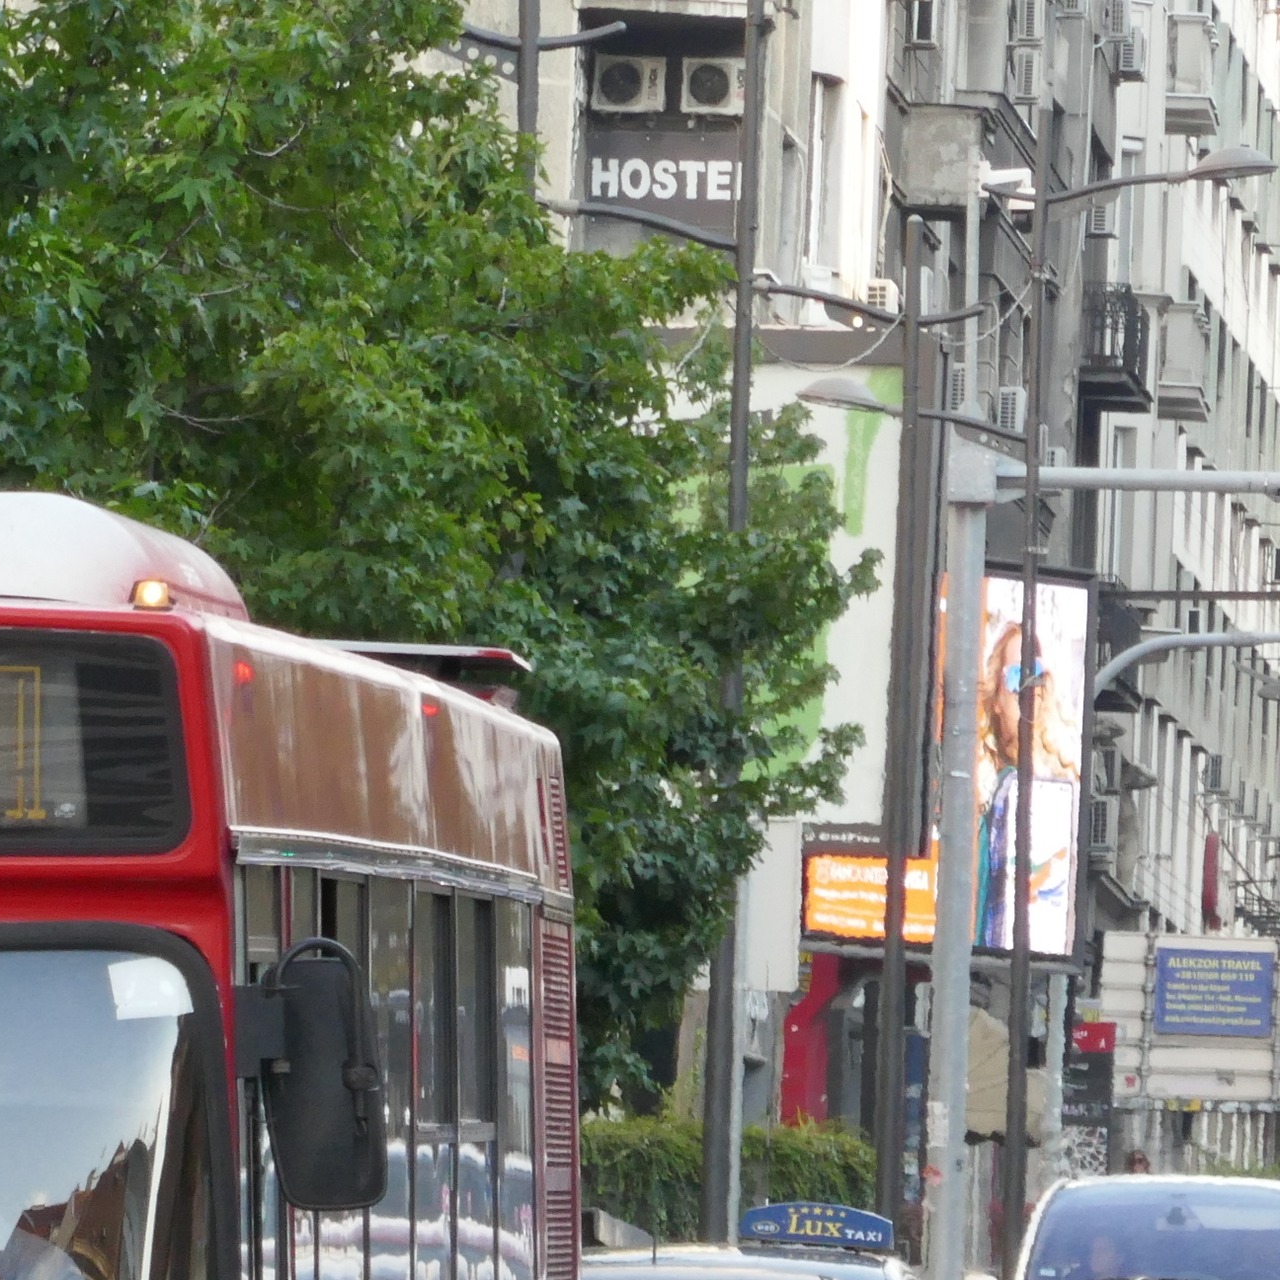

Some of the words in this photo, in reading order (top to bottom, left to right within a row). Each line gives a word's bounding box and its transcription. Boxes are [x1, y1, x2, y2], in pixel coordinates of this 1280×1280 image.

[1221, 959, 1263, 971] TRAVEL
[787, 1213, 843, 1238] Lux
[844, 1228, 883, 1242] TAXI
